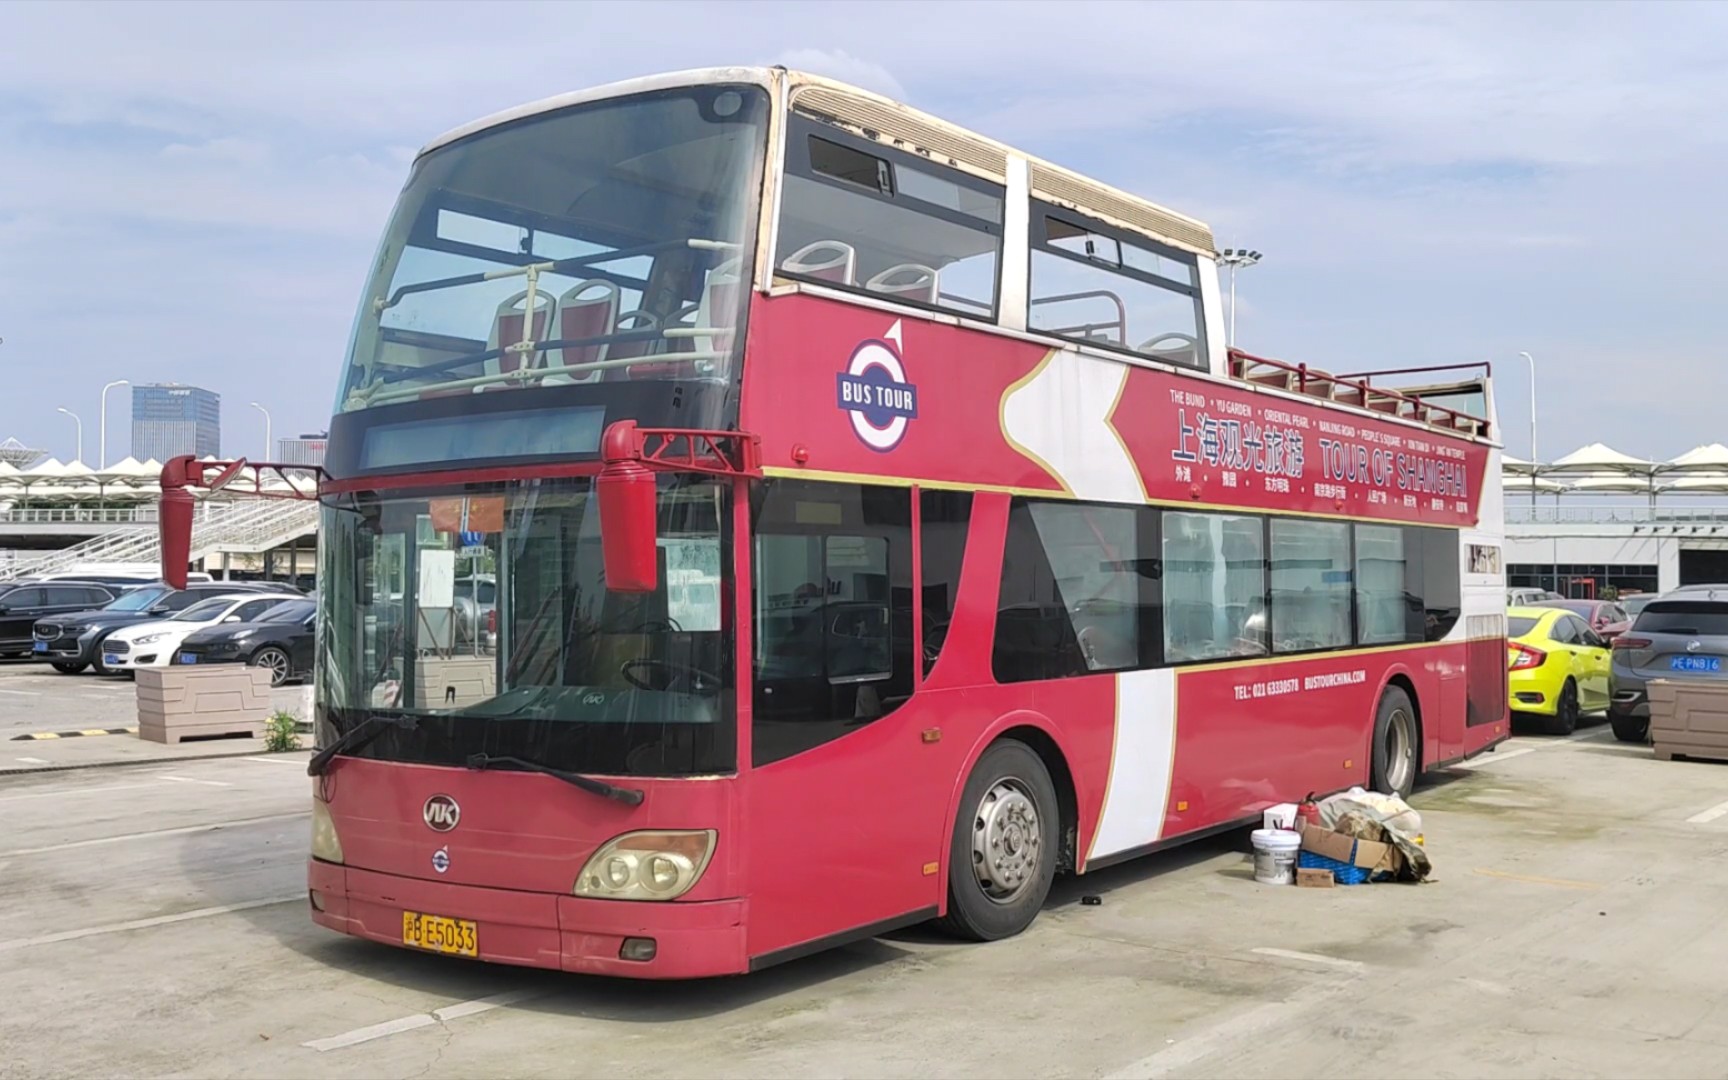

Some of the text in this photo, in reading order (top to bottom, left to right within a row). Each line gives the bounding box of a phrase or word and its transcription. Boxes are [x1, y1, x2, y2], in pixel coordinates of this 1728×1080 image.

[842, 381, 913, 411] BUS TOUR
[1169, 389, 1184, 404] THE
[1185, 392, 1205, 408] BUND
[1216, 399, 1225, 412] YU
[1226, 401, 1252, 417] GARDEN
[1264, 408, 1292, 425] ORIENTAL
[1292, 414, 1310, 429] PEARL
[1171, 408, 1304, 478] 上海观光旅游
[1174, 464, 1191, 483] 外滩
[1319, 438, 1468, 498] TOUR OF SHANGHAI
[1233, 685, 1251, 700] TEL:
[1253, 682, 1266, 698] 021
